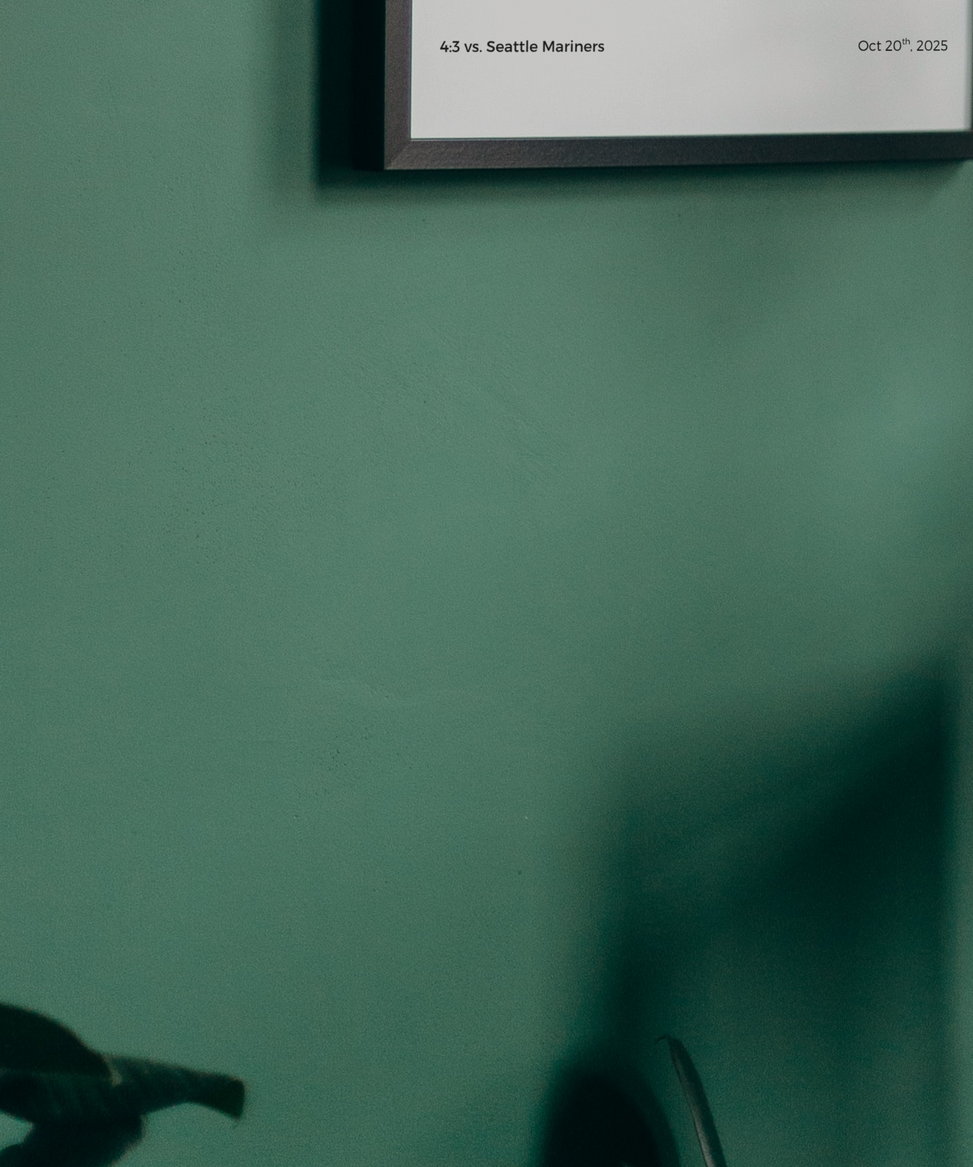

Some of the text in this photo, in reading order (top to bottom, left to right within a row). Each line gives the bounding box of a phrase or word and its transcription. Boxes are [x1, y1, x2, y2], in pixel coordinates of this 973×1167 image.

[439, 40, 605, 53] 4:3 vs. Seattle Mariners
[857, 37, 948, 54] Oct 20th, 2025
